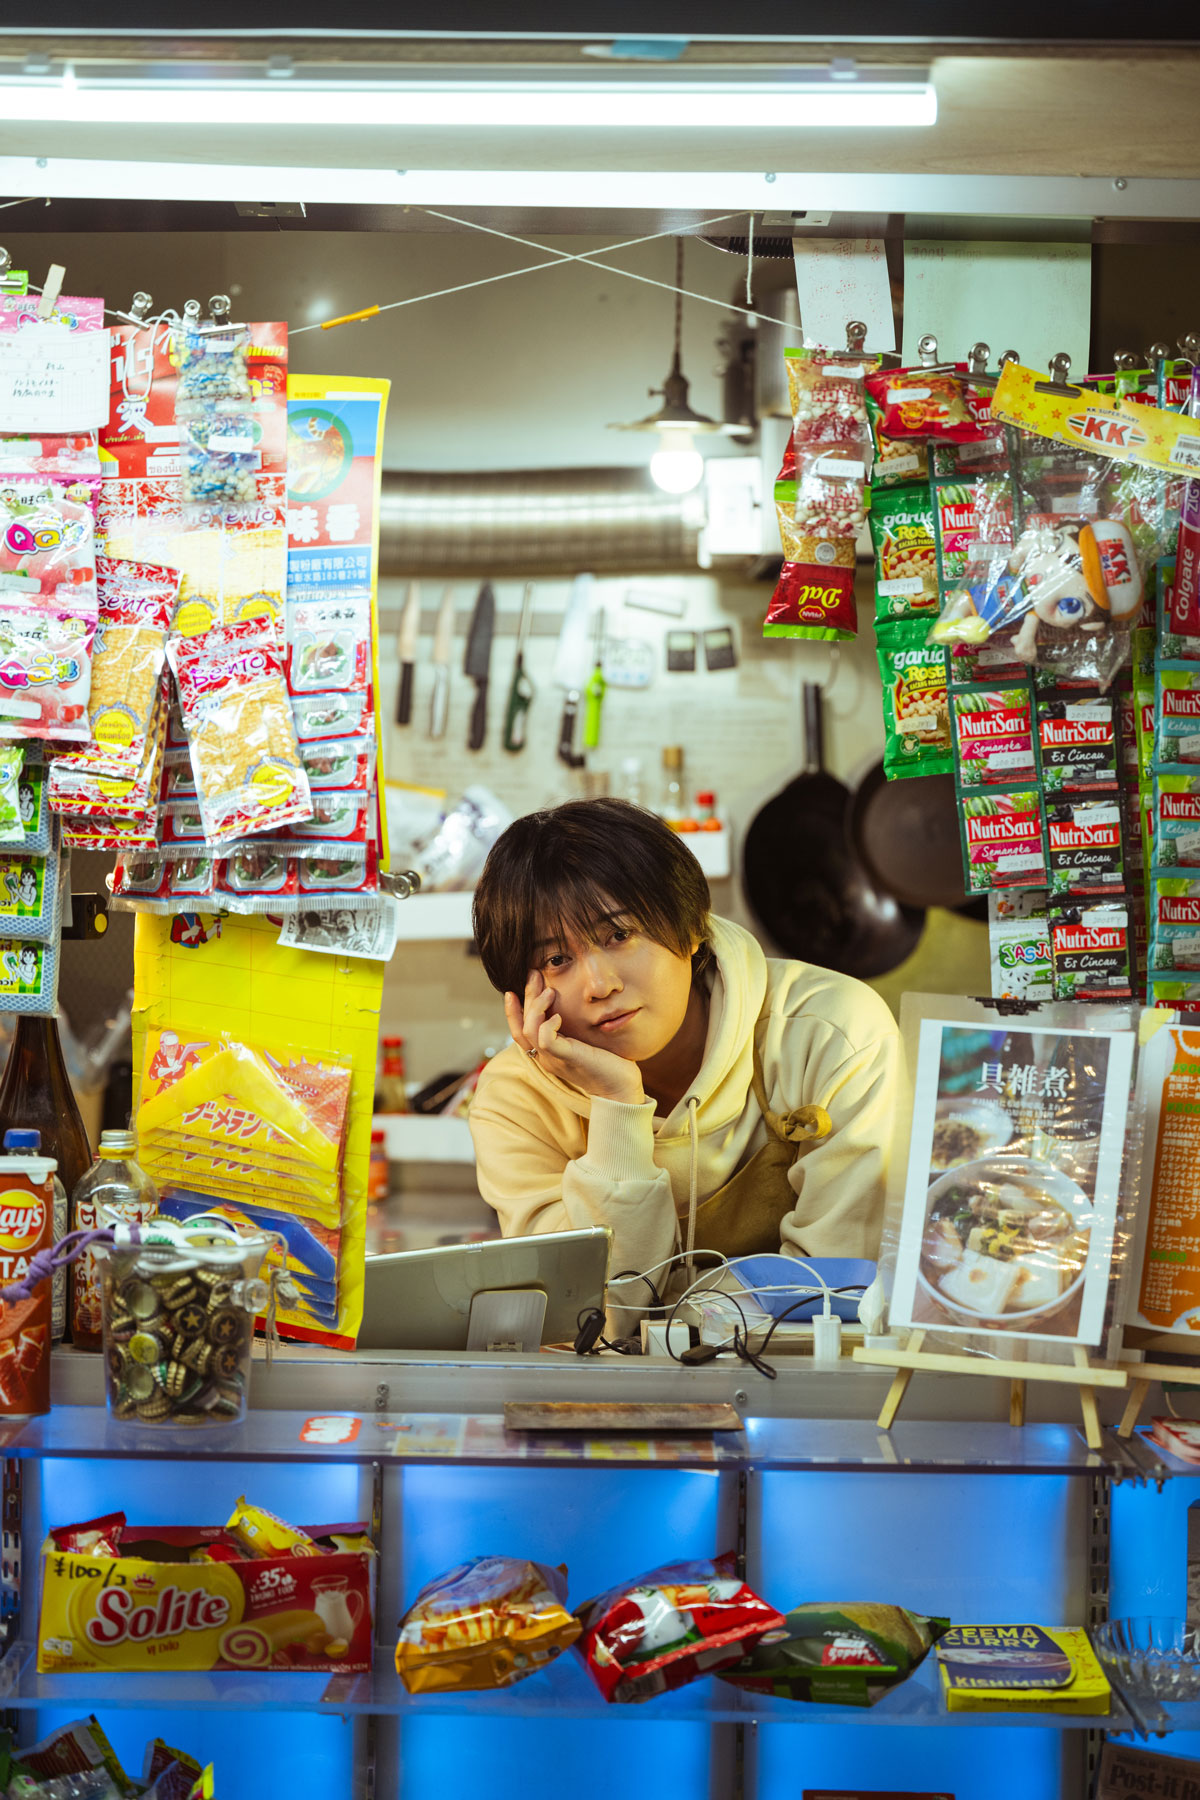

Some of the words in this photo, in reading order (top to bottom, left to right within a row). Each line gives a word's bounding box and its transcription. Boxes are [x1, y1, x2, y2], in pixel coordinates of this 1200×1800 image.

[1084, 416, 1130, 447] KK
[799, 584, 843, 608] Dal
[1176, 549, 1195, 621] Colgate
[959, 709, 1025, 735] NutriSari
[1043, 721, 1107, 744] NutriSari
[972, 740, 1022, 755] Semangka
[1051, 752, 1065, 762] Es
[1067, 750, 1105, 762] Cincau
[970, 816, 1035, 841] NutriSari
[1050, 824, 1114, 846] NutriSari
[982, 844, 1031, 857] Semangka
[1057, 855, 1072, 865] Es
[1074, 852, 1112, 864] Cincau
[1055, 928, 1120, 949] NutriSari
[1064, 957, 1078, 968] Es
[1080, 954, 1118, 967] Cincau
[976, 1062, 1070, 1098] 具雑煮
[87, 1585, 229, 1646] Solite
[944, 1637, 1041, 1649] CURRY
